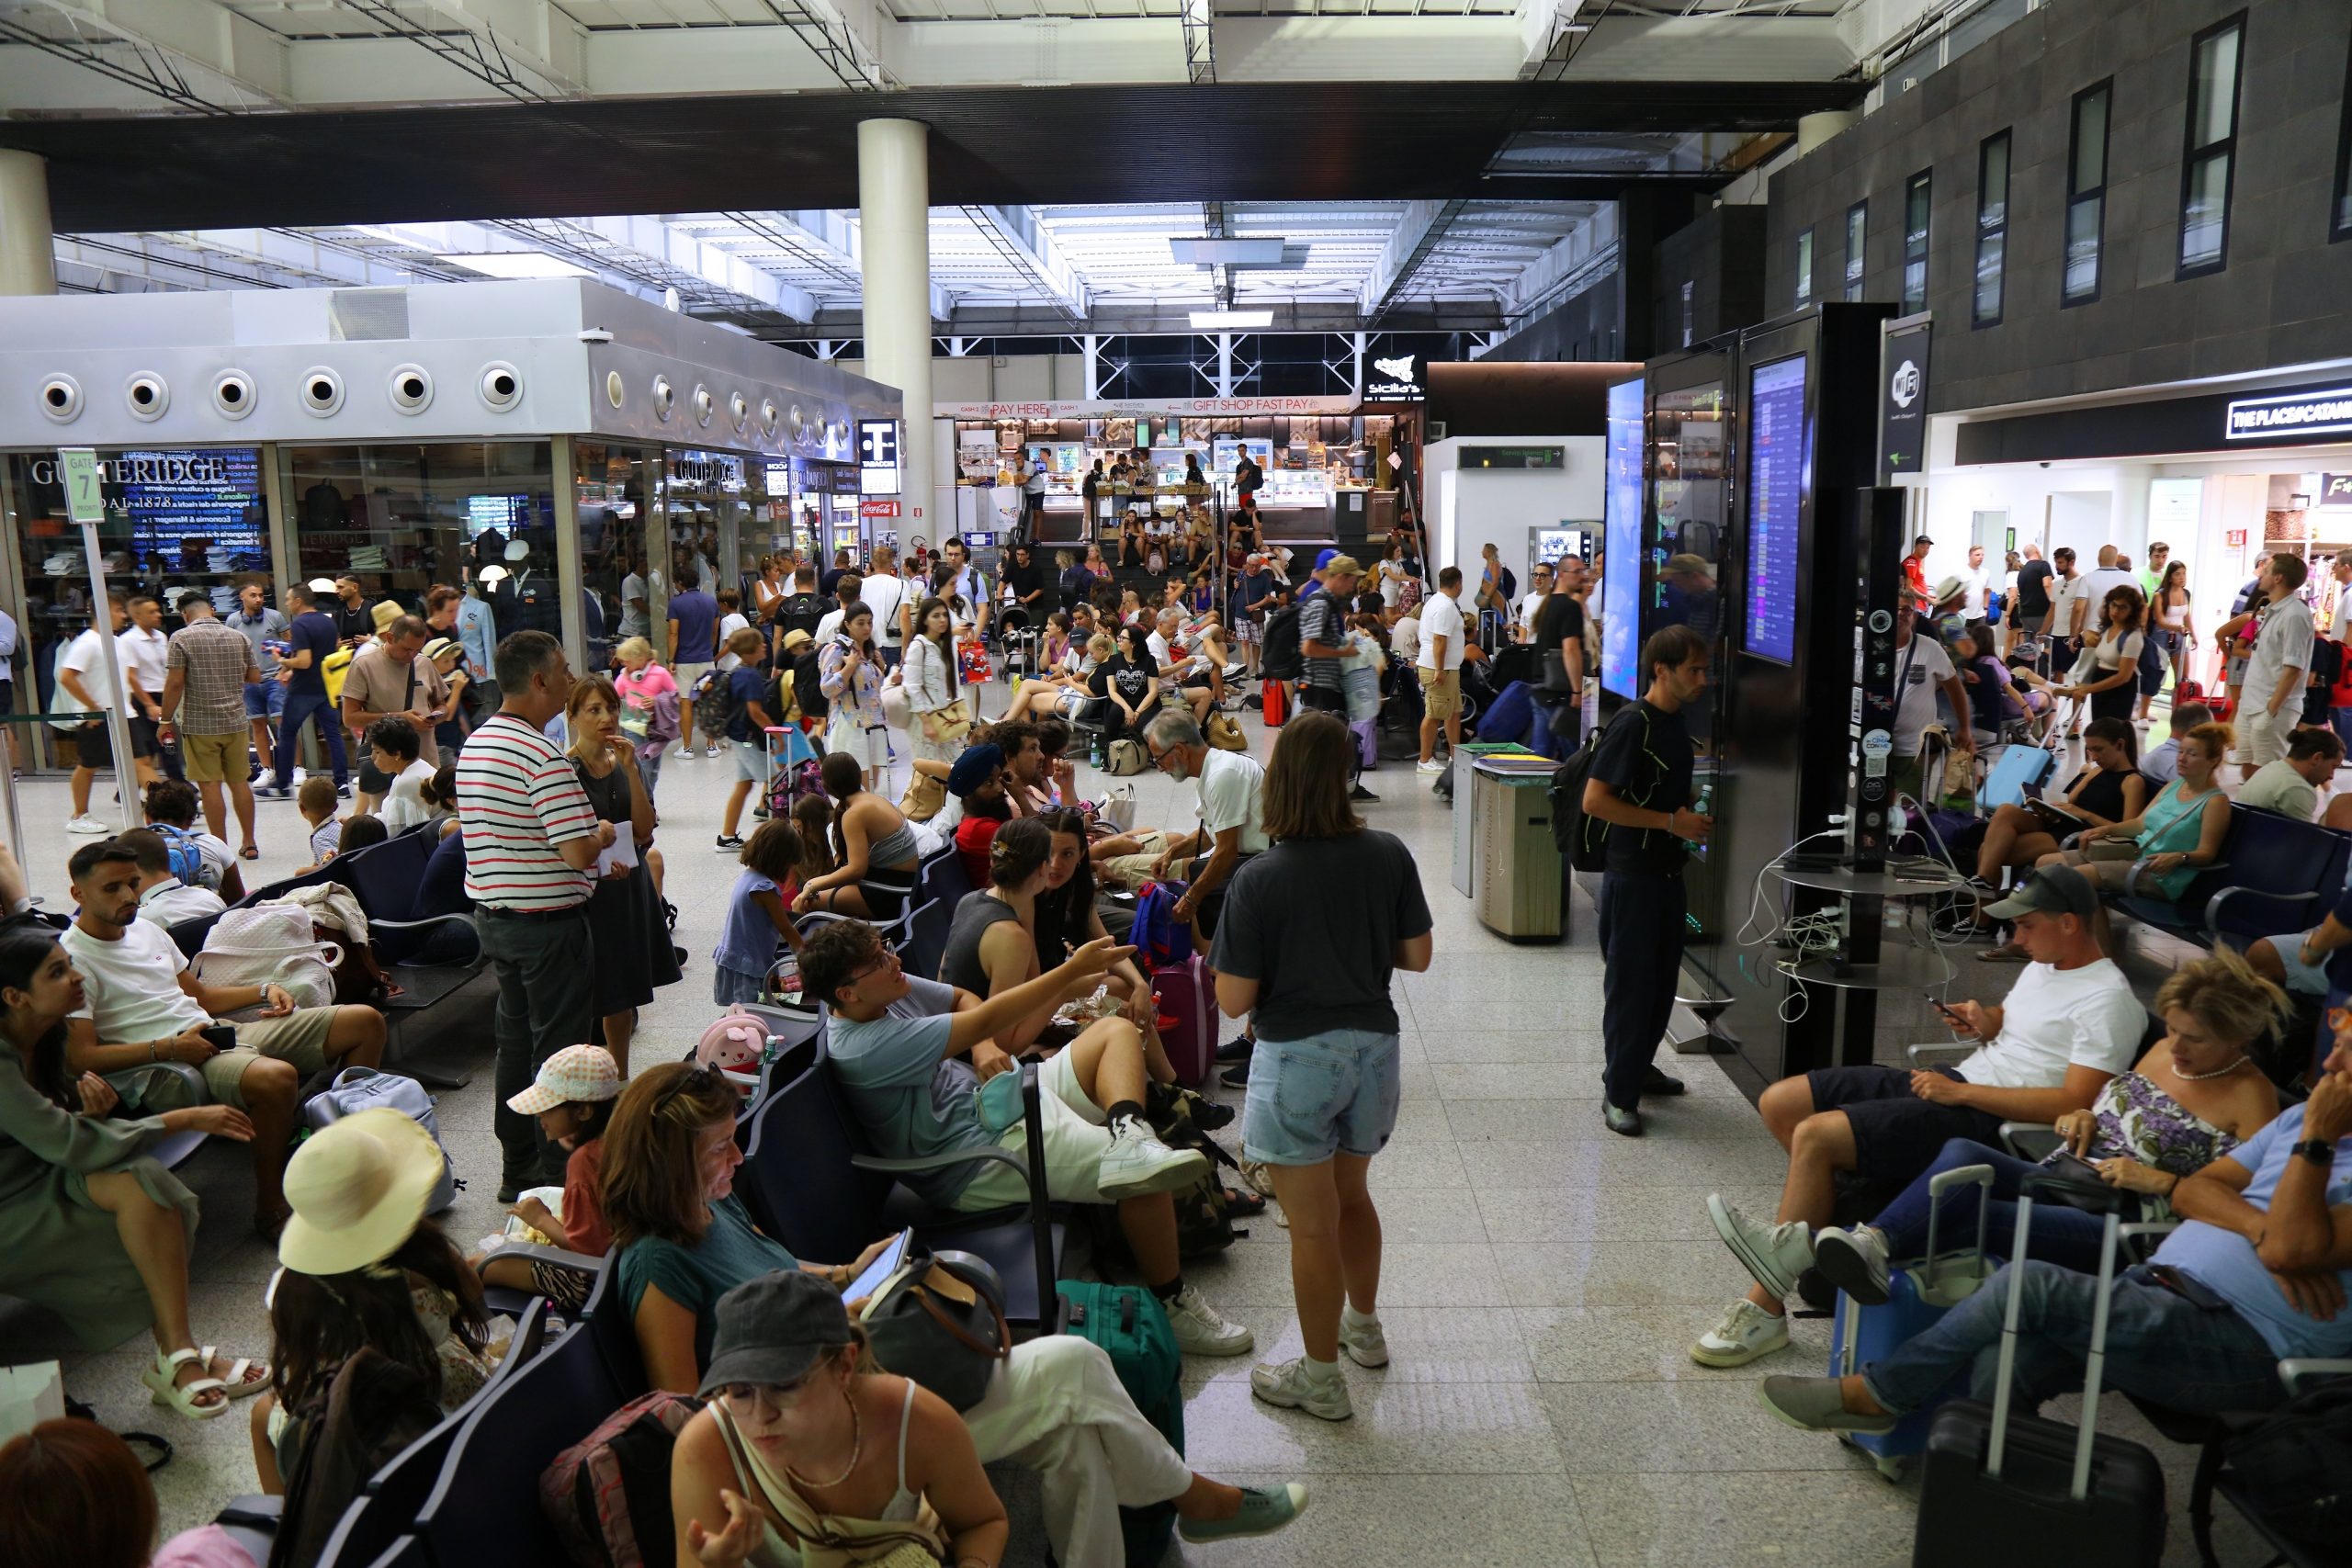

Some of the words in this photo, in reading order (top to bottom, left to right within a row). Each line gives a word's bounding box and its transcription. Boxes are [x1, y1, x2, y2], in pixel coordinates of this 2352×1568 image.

[1368, 383, 1420, 393] Sicilia's
[992, 404, 1014, 415] PAY
[1017, 404, 1046, 414] HERE
[1193, 400, 1217, 412] GIFT
[1220, 400, 1253, 411] SHOP
[1256, 400, 1283, 411] FAST
[1286, 399, 1308, 410] PAY
[70, 457, 94, 469] GATE
[680, 459, 736, 482] GUTTERIDGE
[78, 475, 89, 500] 7
[140, 496, 171, 508] 1878
[863, 503, 891, 514] Coca-Cola
[1485, 794, 1493, 849] ORGANIC
[1484, 853, 1492, 922] ORGANICO
